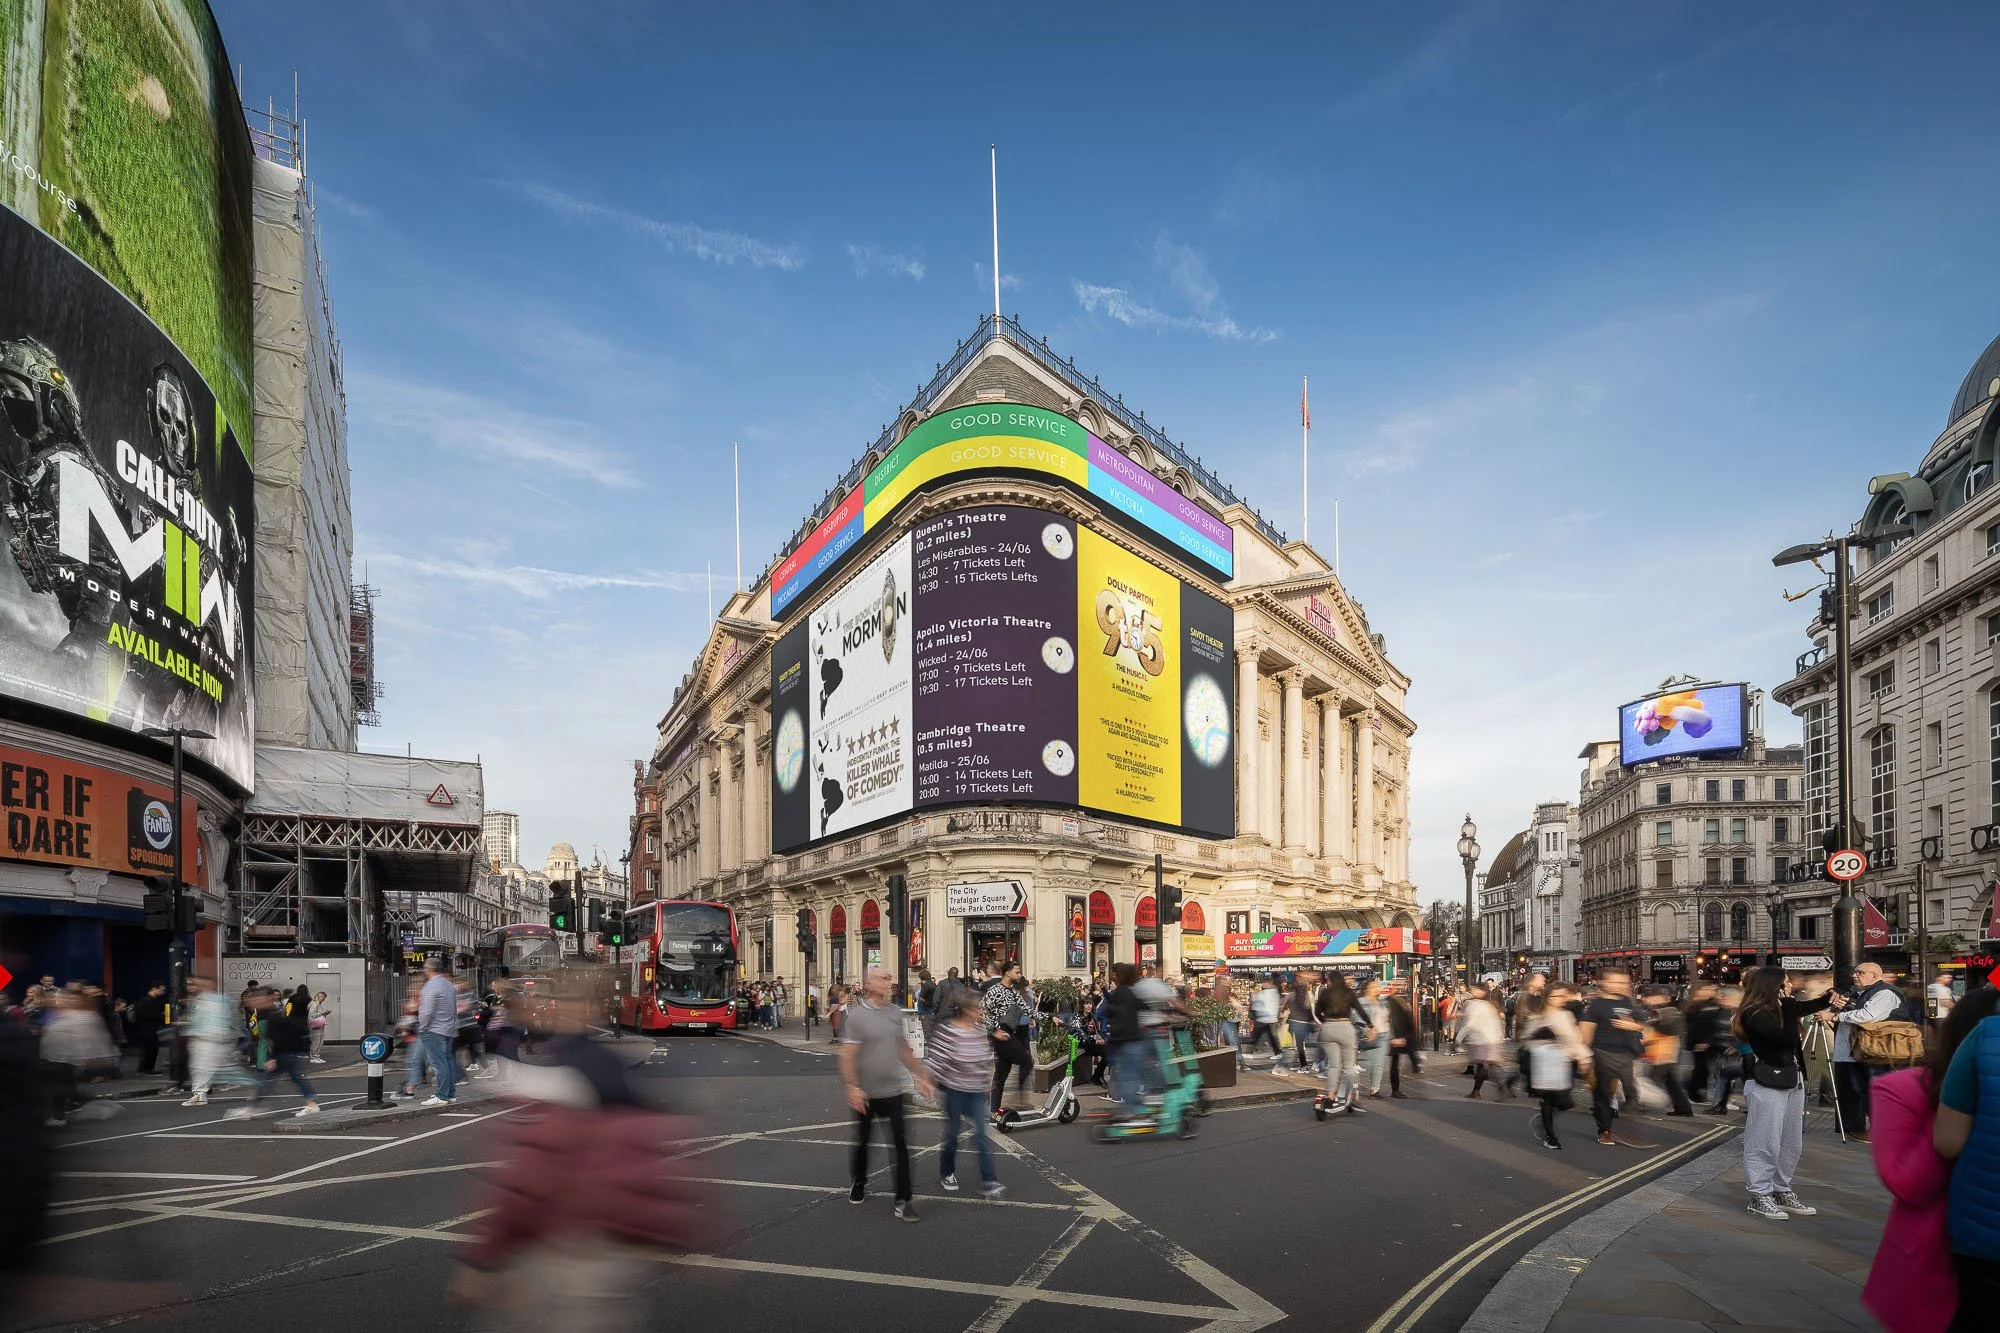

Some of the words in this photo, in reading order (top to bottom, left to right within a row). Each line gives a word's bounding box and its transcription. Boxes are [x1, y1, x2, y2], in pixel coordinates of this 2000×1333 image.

[950, 413, 1001, 430] GOOD
[1009, 413, 1067, 437] SERVICE
[951, 446, 1001, 463] GOOD
[1009, 446, 1067, 469] SERVICE
[874, 454, 900, 487] DISTRICT
[116, 439, 178, 517] CALL
[184, 487, 221, 559] DUTY
[877, 487, 897, 513] CIRCLE
[1098, 448, 1154, 494] METROPOLITAN
[1179, 503, 1200, 523] GOOD
[1202, 518, 1225, 540] SERVICE
[916, 518, 953, 539] Queen's
[957, 512, 1007, 525] Theatre
[1109, 486, 1145, 517] VICTORIA
[1179, 531, 1200, 550] GOOD
[1202, 545, 1225, 567] SERVICE
[779, 559, 797, 580] CENTRAL
[823, 507, 848, 537] DISRUPTED
[818, 548, 833, 569] GOOD
[835, 529, 854, 555] SERVICE
[916, 538, 933, 554] (0.2
[935, 527, 972, 545] miles)
[918, 557, 931, 569] Les
[932, 544, 988, 562] Misérables
[998, 542, 1031, 554] 24/06
[918, 566, 938, 582] 14:30
[953, 560, 960, 571] 7
[962, 558, 1001, 569] Tickets
[1004, 557, 1026, 568] Left
[918, 580, 939, 595] 19:30
[954, 574, 966, 585] 15
[969, 571, 1008, 582] Tickets
[1011, 571, 1038, 583] Lefts
[1107, 576, 1128, 593] DOLLY
[1129, 587, 1154, 607] PARTON
[59, 566, 171, 629] MODERN
[180, 627, 228, 673] WARFARE
[916, 623, 945, 640] Apollo
[949, 616, 999, 630] Victoria
[1003, 616, 1051, 630] Theatre
[916, 640, 933, 654] (1.4
[936, 630, 972, 647] miles)
[1096, 588, 1125, 657] 9
[1137, 609, 1165, 677] 5
[1190, 627, 1205, 641] SAVOY
[1205, 635, 1224, 651] THEATRE
[107, 622, 200, 688] AVAILABLE
[202, 669, 223, 704] NOW
[918, 653, 947, 670] Wicked
[956, 648, 988, 661] 24/06
[1116, 663, 1126, 674] THE
[918, 668, 939, 683] 17:00
[954, 665, 960, 675] 9
[963, 663, 1002, 673] Tickets
[1005, 662, 1026, 672] Left
[918, 682, 939, 696] 19:30
[954, 678, 967, 688] 17
[969, 676, 1009, 687] Tickets
[1011, 676, 1033, 686] Left
[917, 724, 971, 742] Cambridge
[975, 722, 1026, 732] Theatre
[917, 743, 934, 756] (0.5
[936, 736, 973, 751] miles)
[847, 762, 870, 783] KILLER
[871, 749, 900, 772] WHALE
[919, 758, 949, 773] Matilda
[957, 754, 990, 767] 25/06
[919, 773, 939, 786] 16:00
[955, 770, 966, 781] 14
[969, 769, 1009, 779] Tickets
[1012, 769, 1033, 779] Left
[63, 773, 93, 818] IF
[847, 782, 859, 800] OF
[919, 787, 940, 800] 20:00
[955, 784, 967, 794] 19
[970, 783, 1009, 793] Tickets
[1012, 783, 1033, 793] Left
[8, 811, 92, 859] DARE
[144, 813, 172, 833] FANTA
[130, 847, 174, 868] SPOOKBOO
[1834, 858, 1860, 872] 20
[950, 897, 980, 905] Trafalgar
[982, 895, 1007, 904] Square
[963, 887, 977, 895] City
[968, 905, 984, 913] Park
[985, 904, 1009, 912] Corner
[712, 943, 724, 952] 14
[229, 962, 277, 971] COMING
[1973, 955, 1995, 967] Cafe
[229, 972, 242, 980] Q1
[245, 972, 273, 980] 2023
